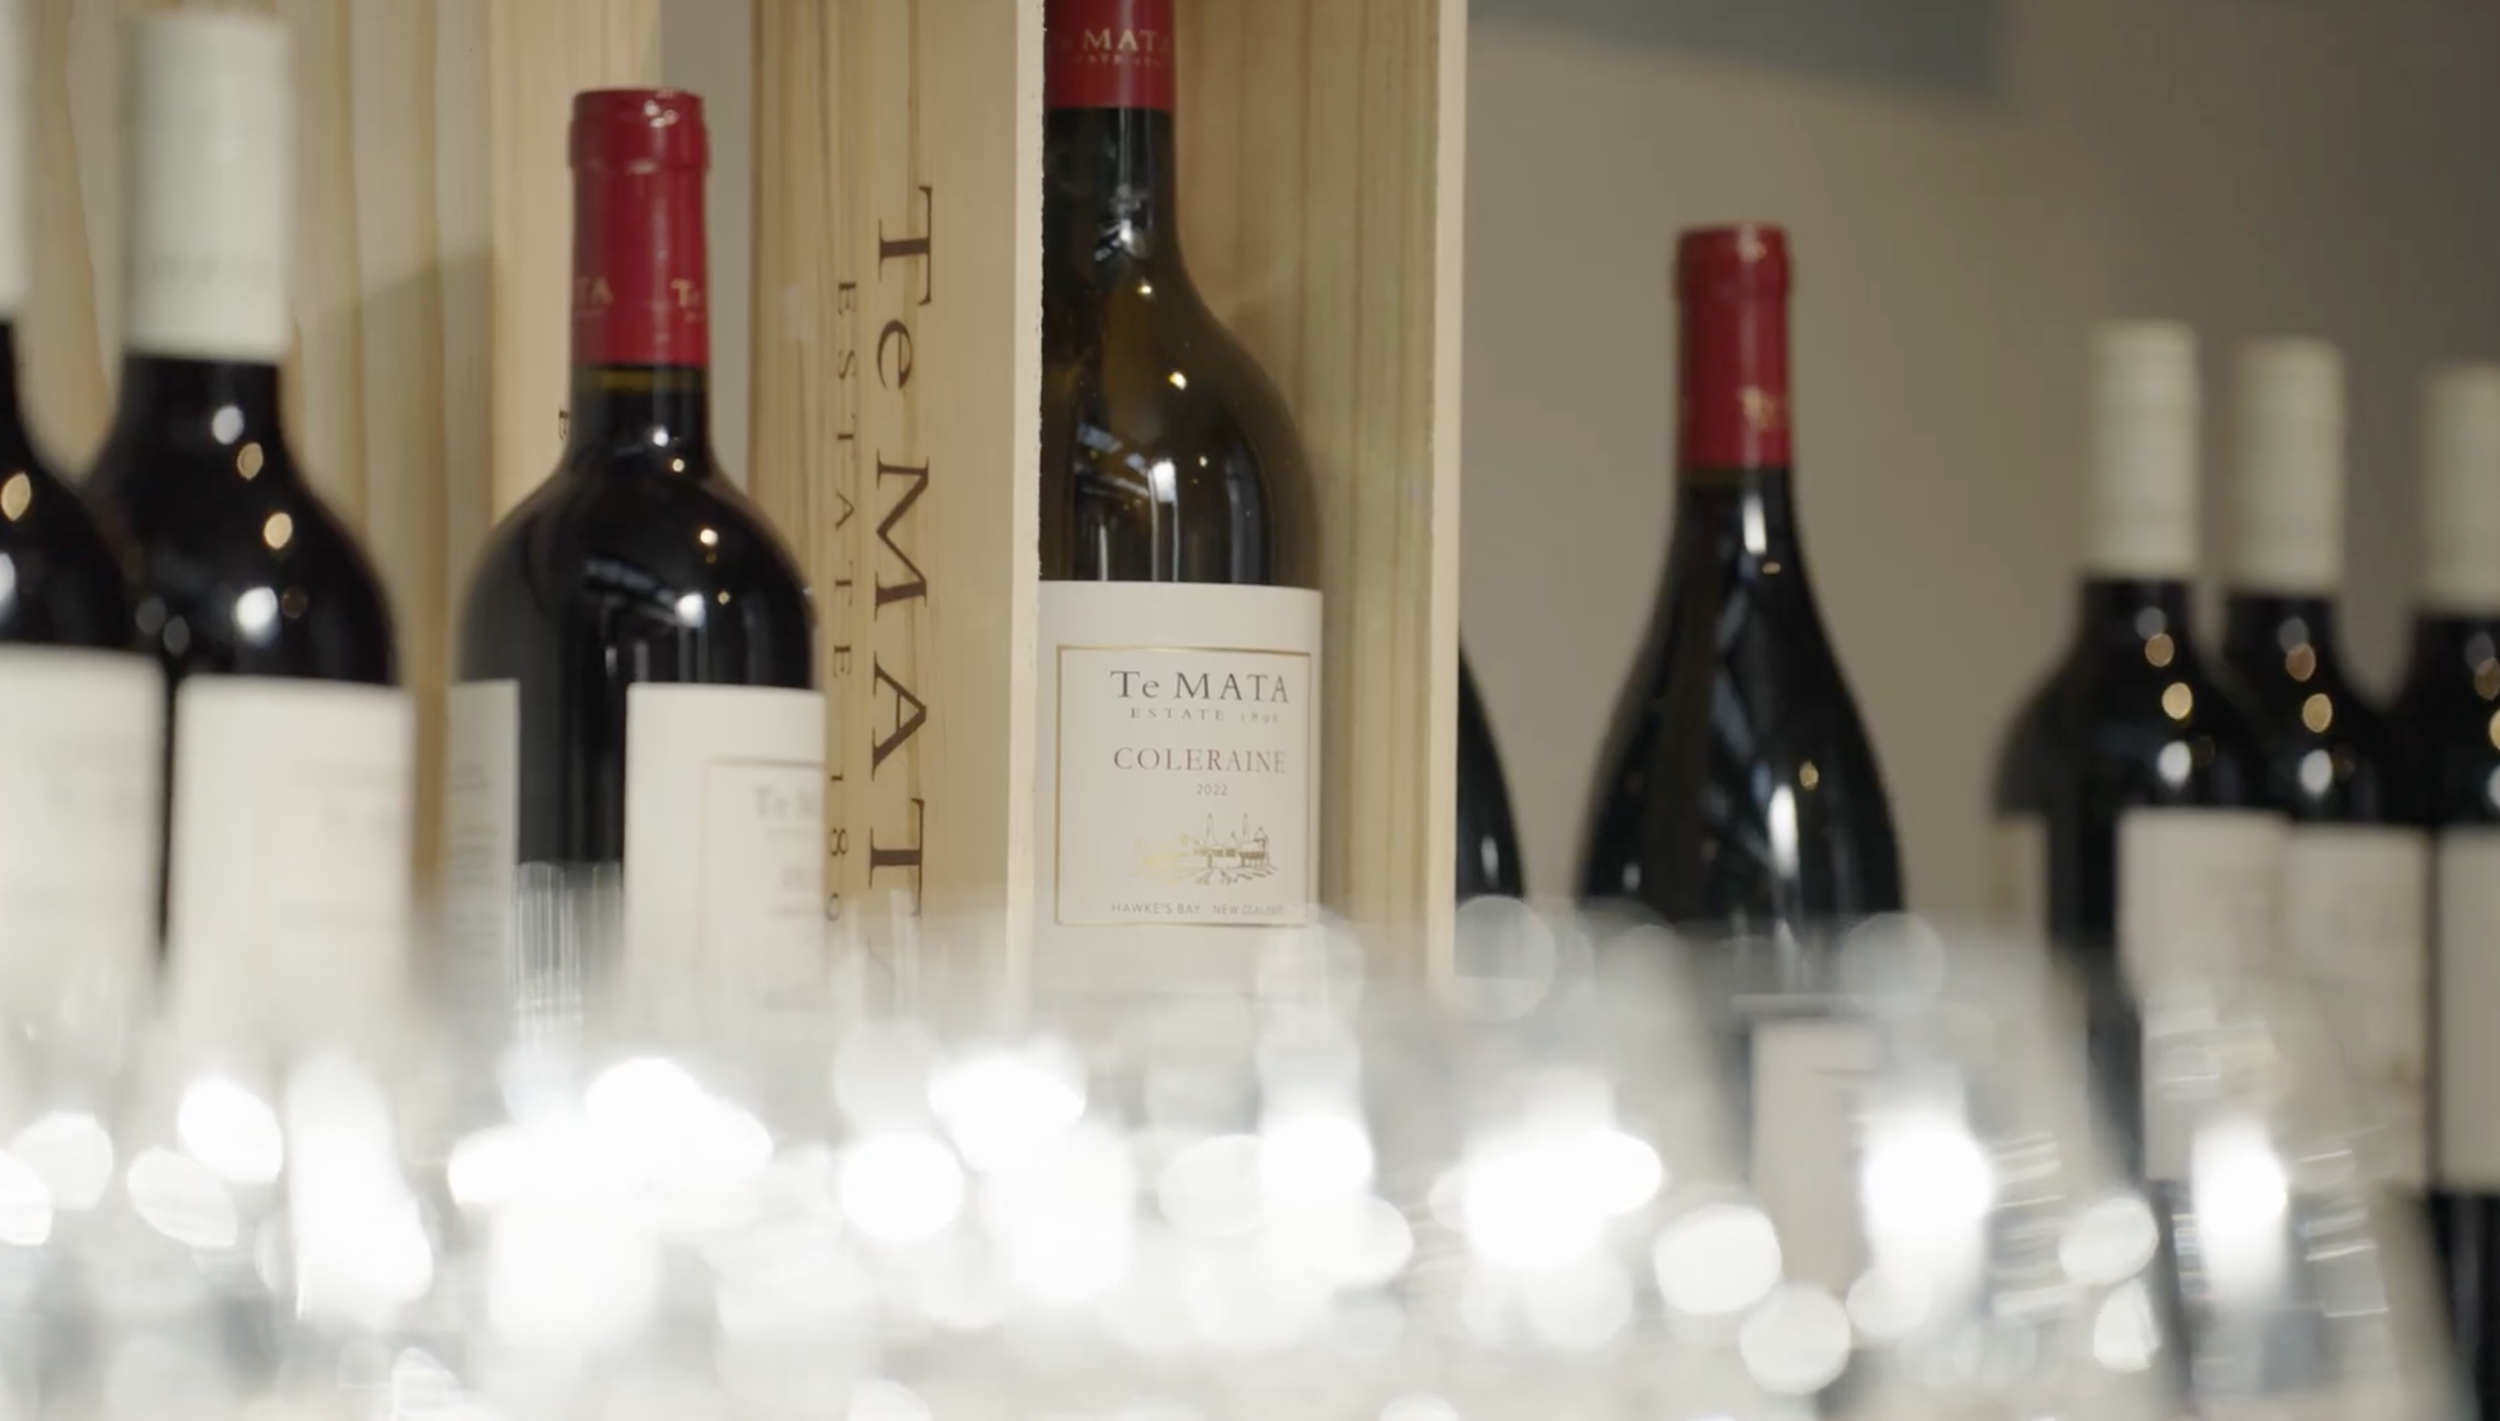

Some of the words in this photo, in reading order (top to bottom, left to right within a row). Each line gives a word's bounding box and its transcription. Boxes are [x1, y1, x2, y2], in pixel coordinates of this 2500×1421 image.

[876, 185, 933, 391] Te
[833, 280, 857, 678] ESTATE
[1110, 669, 1160, 699] Te
[1173, 671, 1290, 703] MATA
[1130, 706, 1226, 721] ESTATE
[1113, 746, 1287, 774] COLERAINE
[1196, 783, 1228, 797] 2022
[1111, 902, 1173, 915] HAWKE'S
[1176, 903, 1201, 915] BAY
[1212, 904, 1238, 916] NEW
